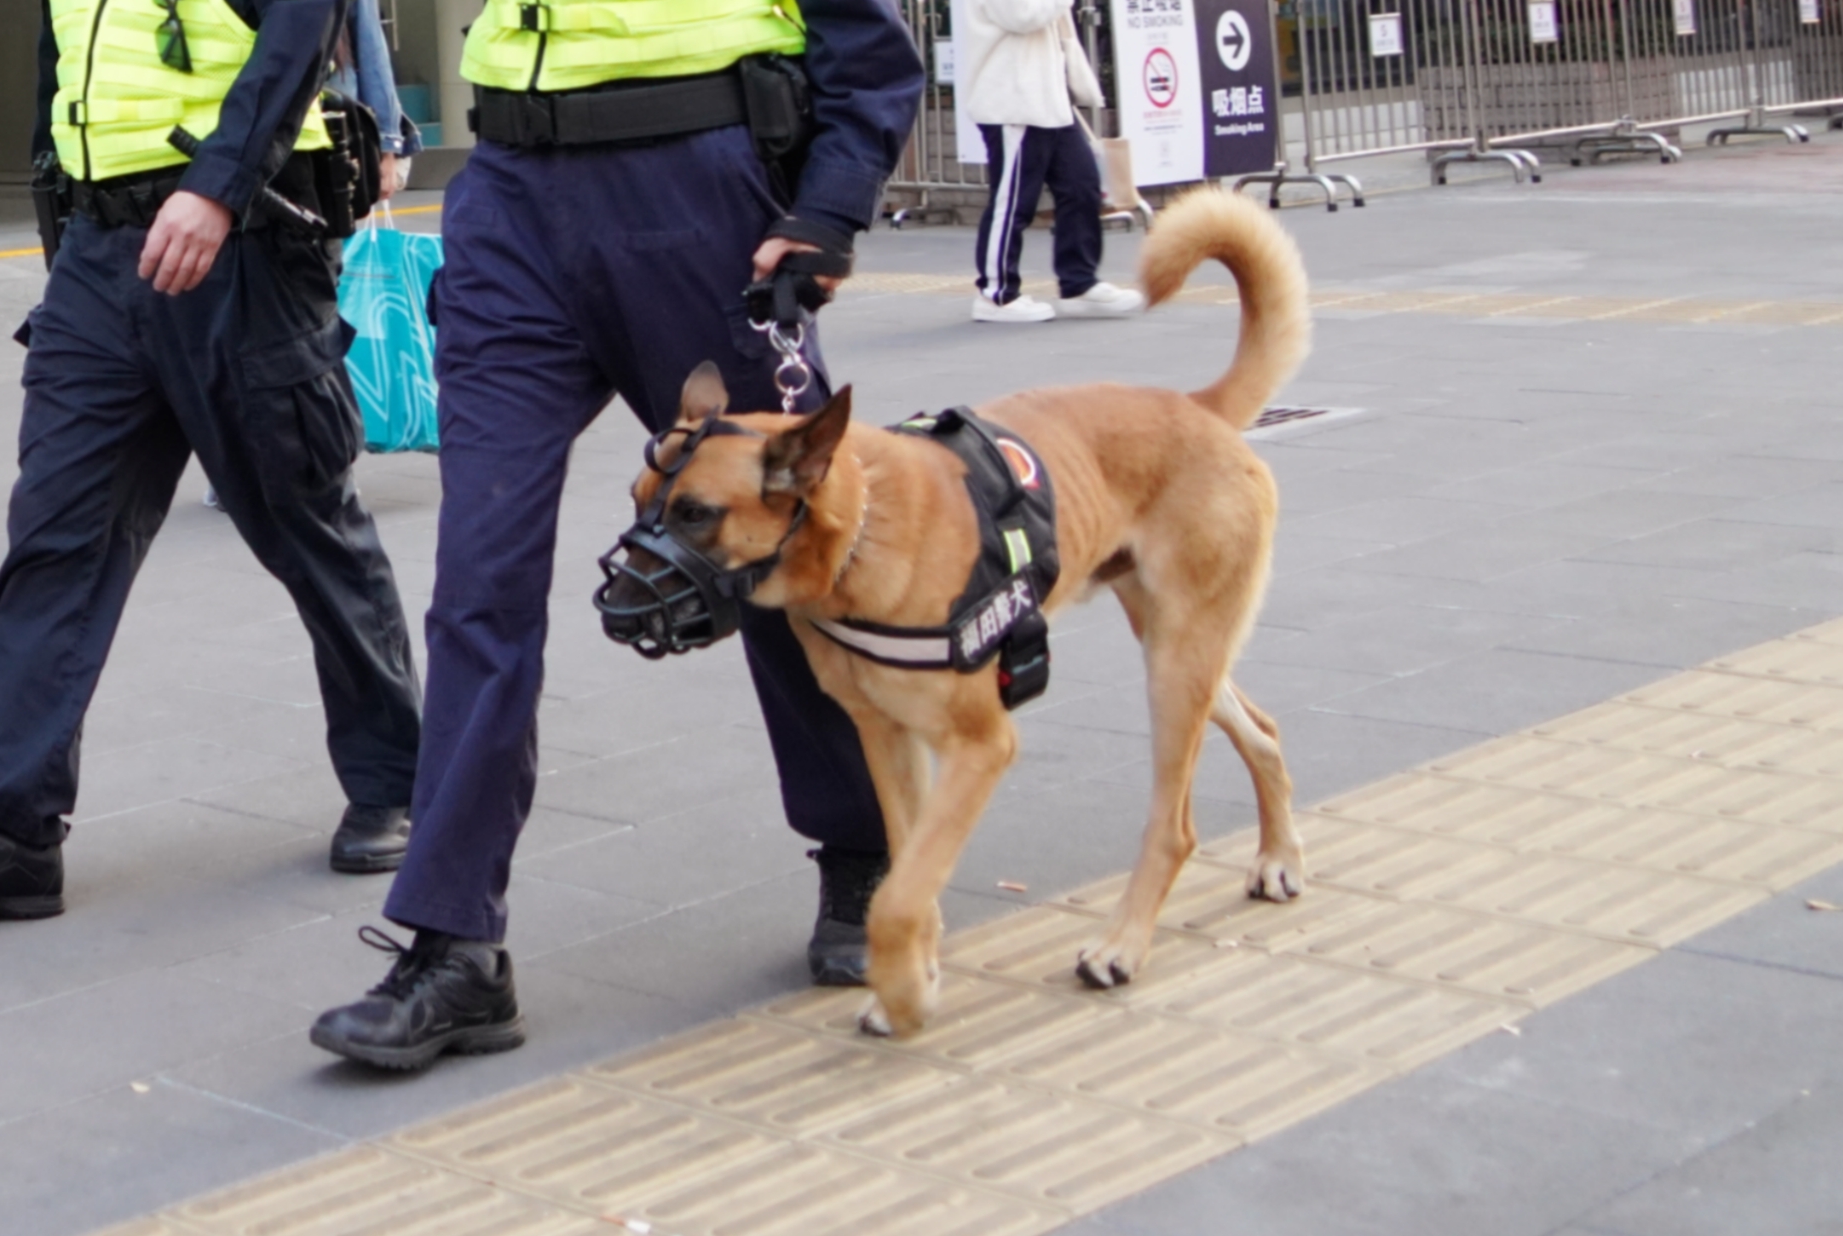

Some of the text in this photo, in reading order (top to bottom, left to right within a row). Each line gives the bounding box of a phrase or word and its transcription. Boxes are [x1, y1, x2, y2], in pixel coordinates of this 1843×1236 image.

[1127, 15, 1183, 29] NO SMOKING
[1212, 85, 1264, 117] 吸烟点
[1214, 123, 1264, 136] Smoking Area
